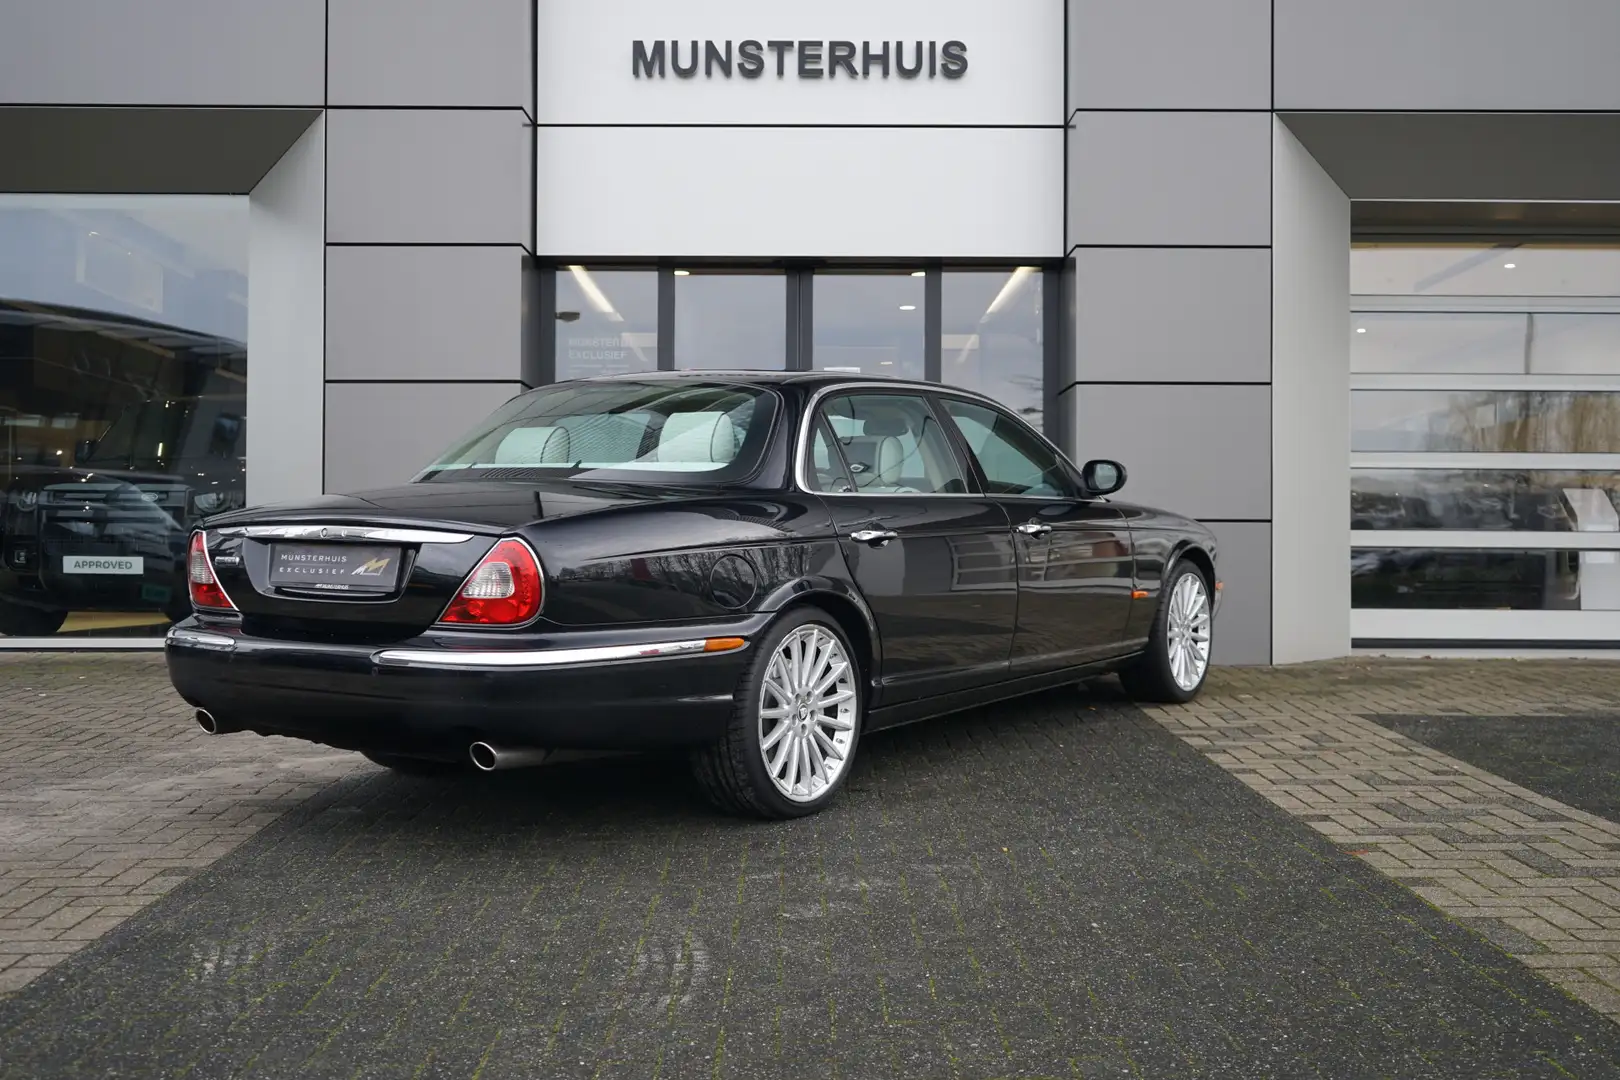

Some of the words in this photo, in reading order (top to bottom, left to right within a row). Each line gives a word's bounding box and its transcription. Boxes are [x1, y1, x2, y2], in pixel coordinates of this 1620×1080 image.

[632, 40, 968, 77] MUNSTERHUIS
[568, 349, 627, 360] EXCLUSIEF
[280, 553, 348, 563] MUNSTERHUIS
[73, 560, 133, 570] APPROVED
[279, 566, 345, 575] EXCLUSIEF
